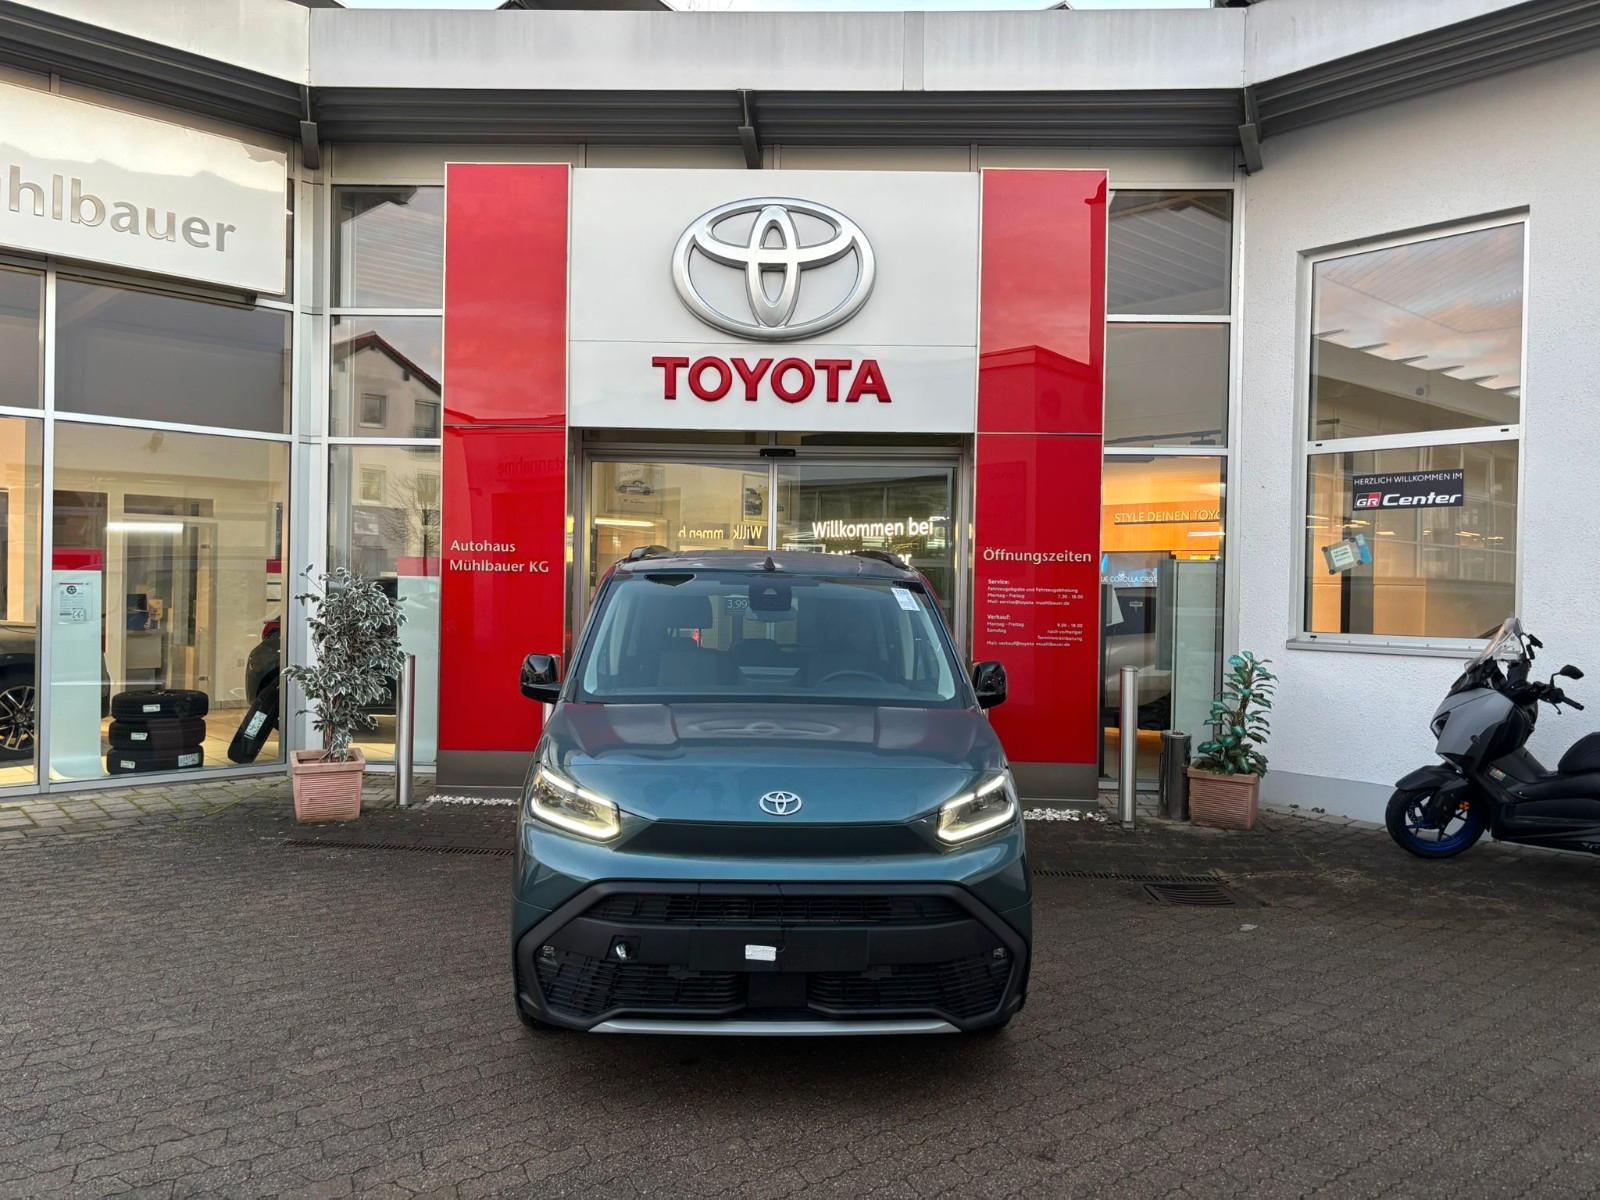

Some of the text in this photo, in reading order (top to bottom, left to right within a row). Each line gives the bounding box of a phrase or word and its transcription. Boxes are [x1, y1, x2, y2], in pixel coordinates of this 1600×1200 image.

[0, 165, 236, 251] hlbauer
[652, 356, 892, 403] TOYOTA
[1354, 472, 1462, 486] HERZLICH WILLKOMMEN IM
[1356, 491, 1462, 507] GR Center
[1114, 511, 1144, 523] STYLE
[1147, 510, 1190, 522] DEINEN
[812, 516, 933, 538] Willkommen bei
[450, 540, 516, 552] Autohaus
[983, 546, 1092, 565] Öffnungszeiten
[449, 559, 549, 573] Mühlbauer KG
